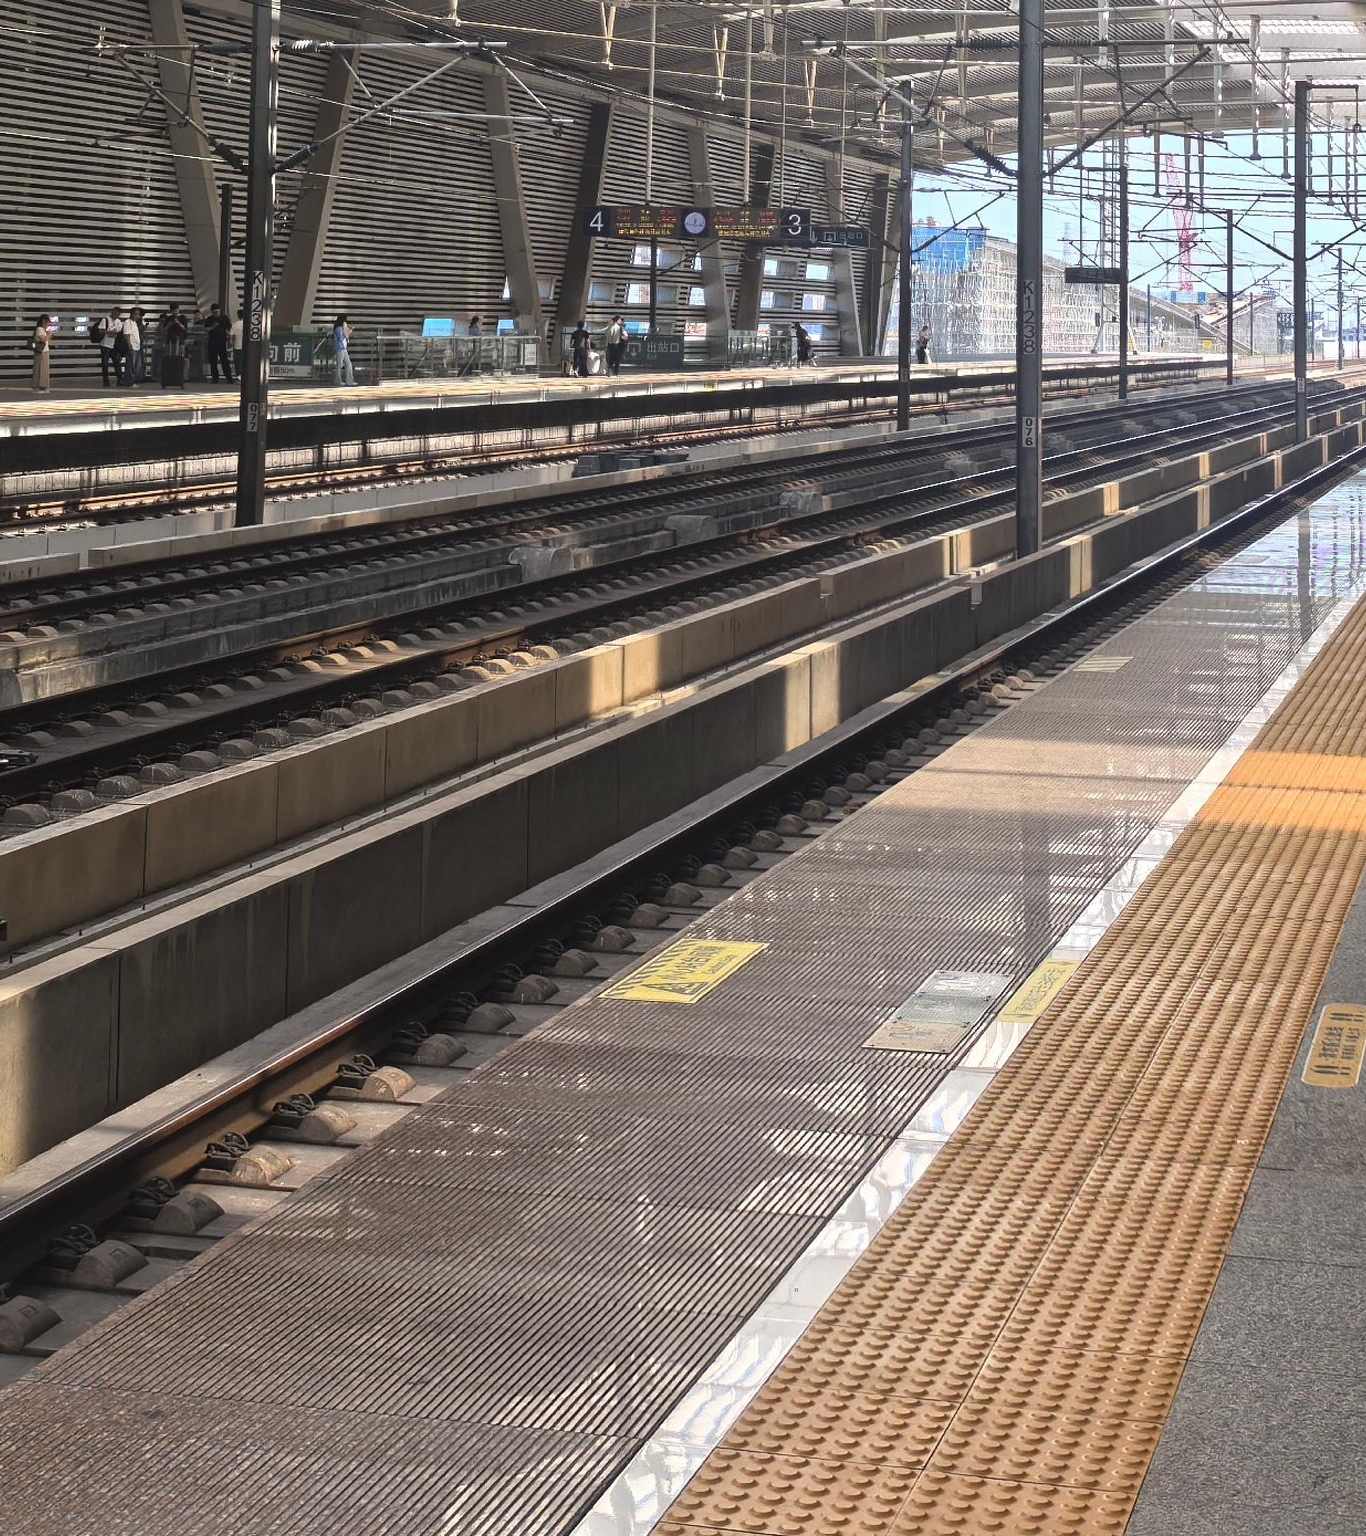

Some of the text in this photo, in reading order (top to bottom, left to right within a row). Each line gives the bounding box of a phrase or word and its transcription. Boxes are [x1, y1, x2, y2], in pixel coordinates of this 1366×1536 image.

[590, 211, 604, 232] 4
[788, 214, 802, 235] 3
[251, 271, 263, 341] K1238
[1023, 281, 1035, 354] K1238
[647, 342, 680, 353] 出站口
[249, 404, 258, 431] 077
[1025, 418, 1034, 446] 076
